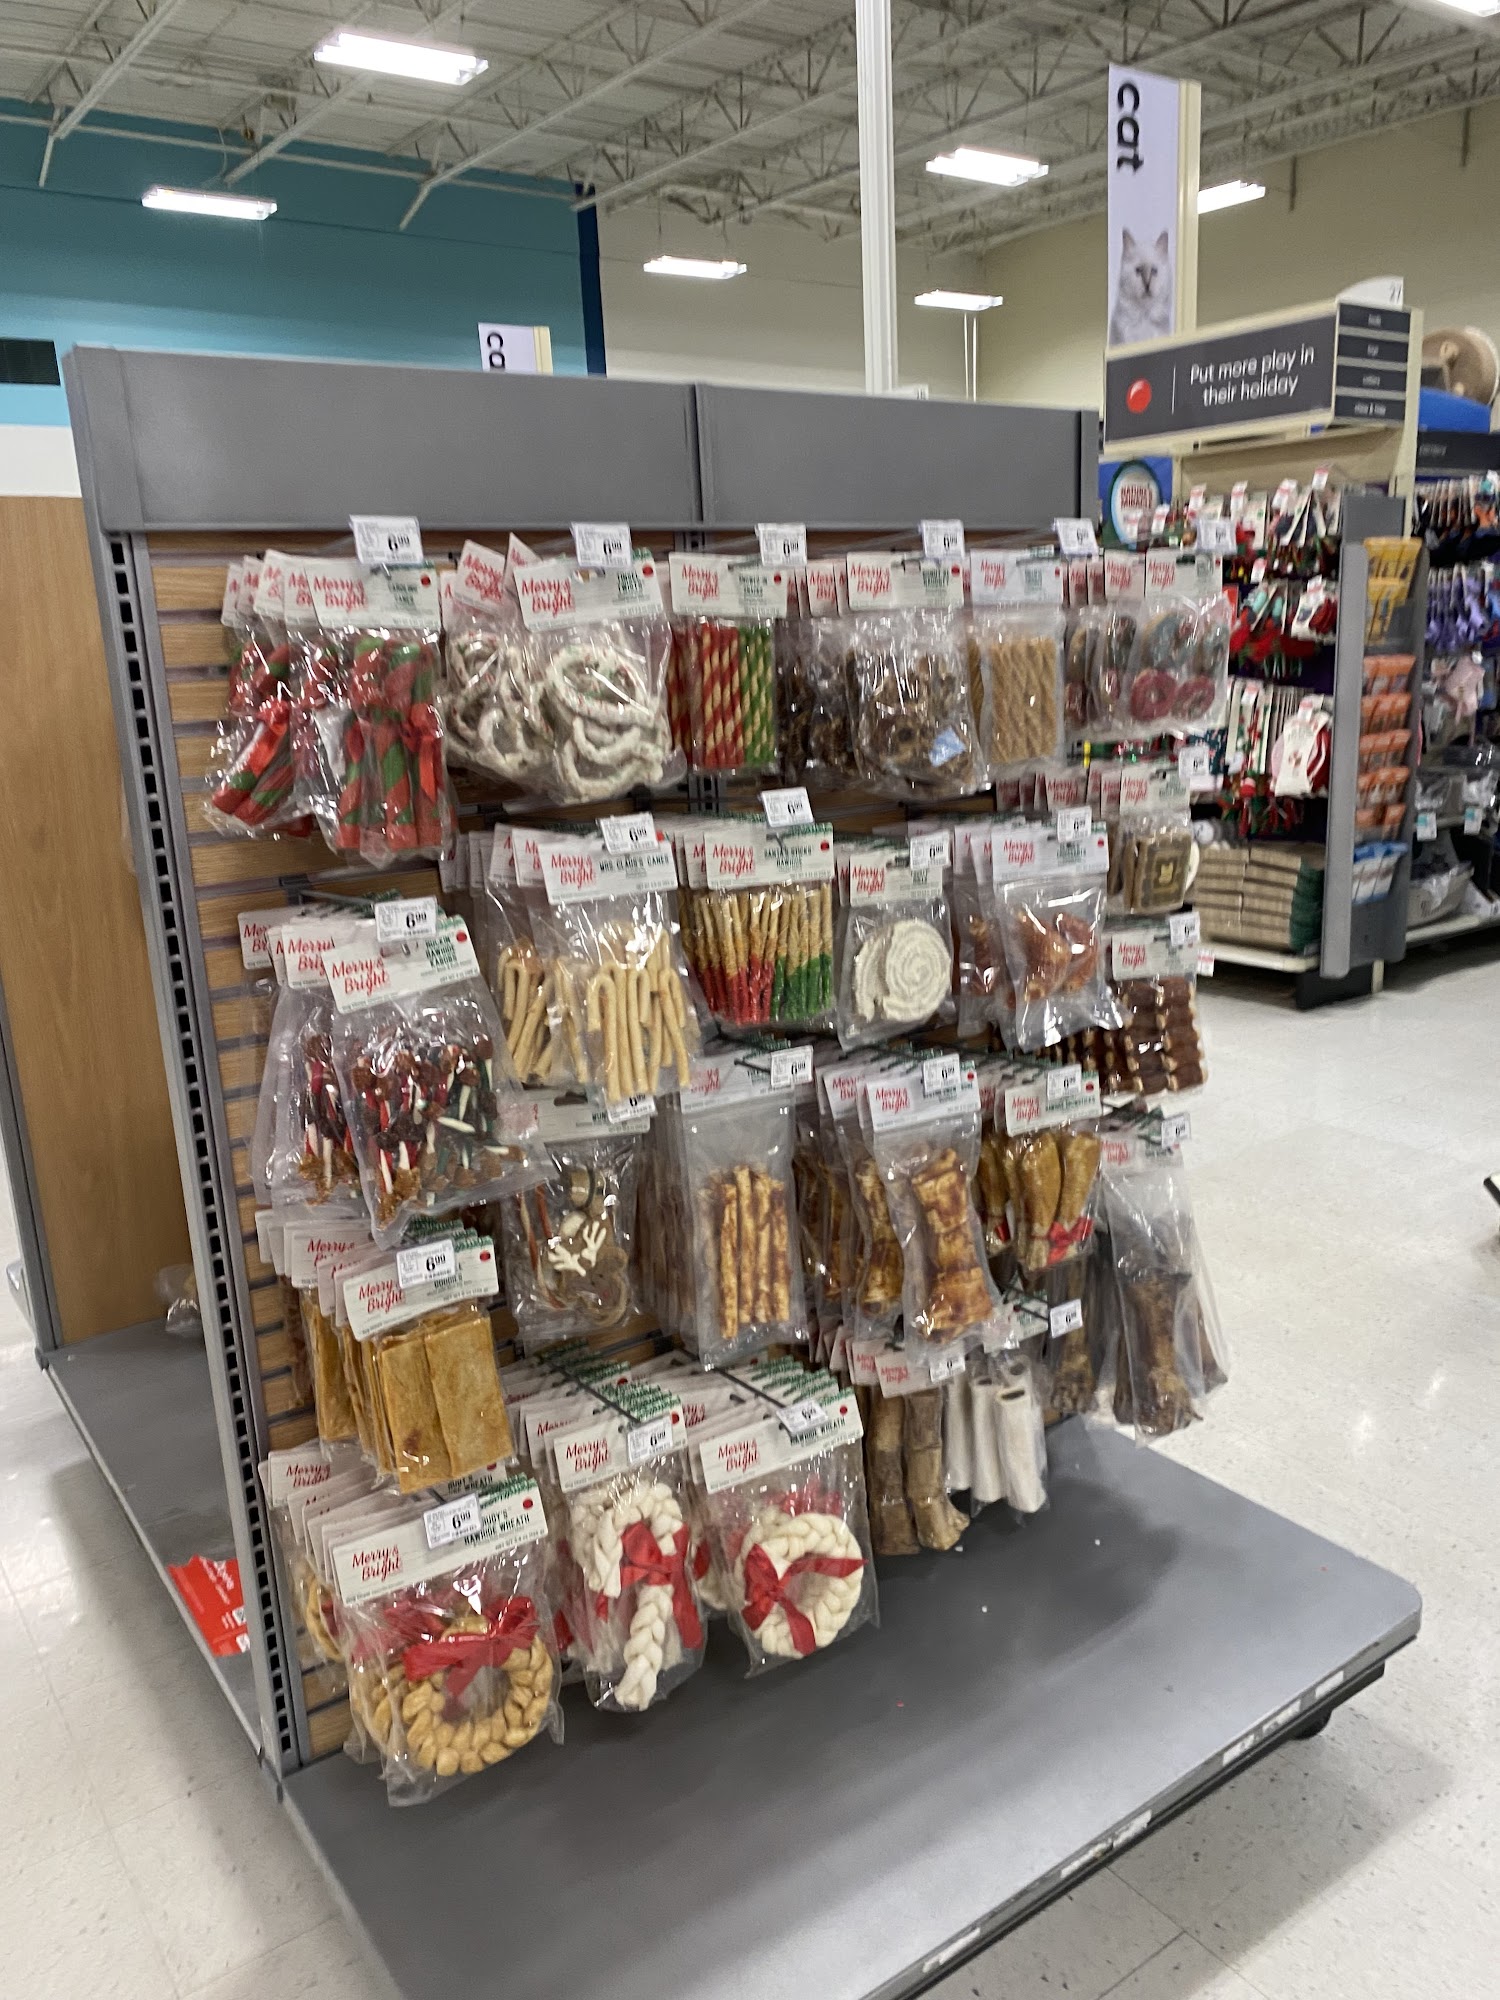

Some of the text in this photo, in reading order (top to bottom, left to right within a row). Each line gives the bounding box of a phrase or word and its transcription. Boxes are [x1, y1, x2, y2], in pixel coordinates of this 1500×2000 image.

[1117, 82, 1144, 175] cat
[1190, 343, 1315, 386] Put more play in
[1203, 373, 1299, 407] their holiday
[551, 853, 586, 874] Merry
[560, 868, 595, 890] Bright
[332, 960, 373, 980] Merry
[345, 971, 386, 997] Bright
[359, 1280, 394, 1301] Merry
[367, 1290, 403, 1314] Bright
[567, 1440, 602, 1460] Merry
[718, 1439, 752, 1460] Merry
[575, 1451, 609, 1473] Bright
[726, 1450, 758, 1473] Bright
[352, 1547, 391, 1569] Merry
[362, 1558, 400, 1582] Bright
